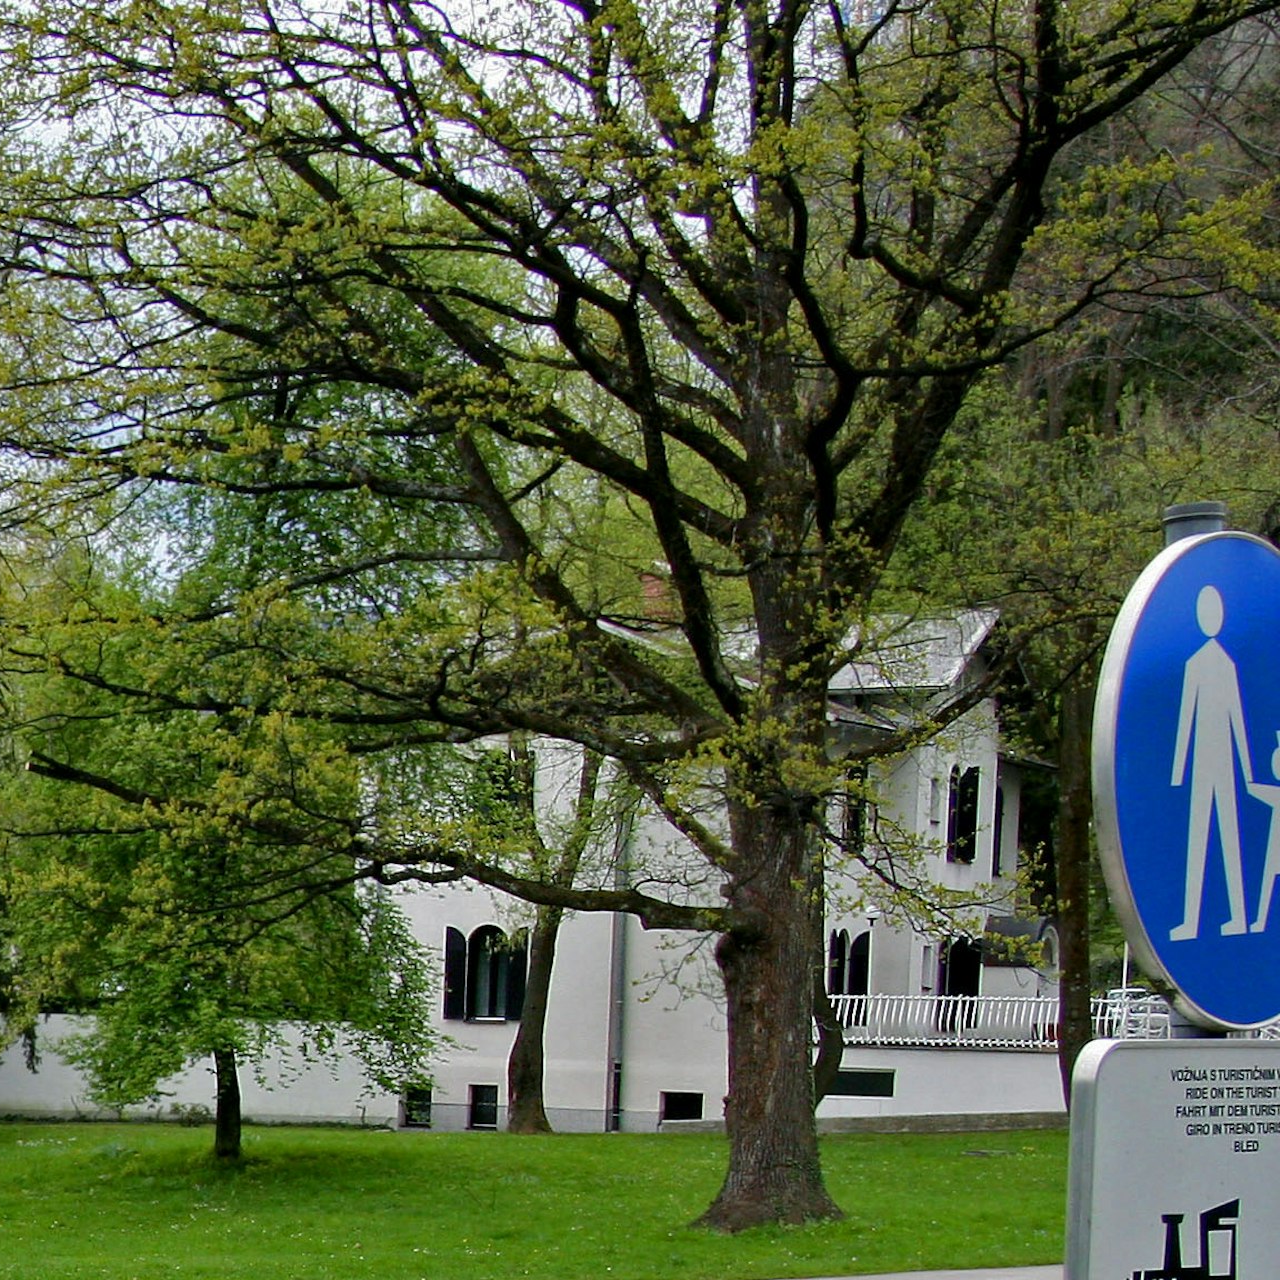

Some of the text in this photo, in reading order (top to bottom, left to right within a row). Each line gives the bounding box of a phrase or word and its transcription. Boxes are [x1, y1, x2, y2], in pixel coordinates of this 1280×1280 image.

[1171, 1066, 1207, 1081] VOŽNJA
[1210, 1069, 1216, 1080] S
[1218, 1066, 1275, 1080] TURISTIČNIM
[1186, 1087, 1277, 1099] RIDE ON THE TURIST
[1176, 1106, 1206, 1117] FAHRT
[1210, 1106, 1225, 1116] MIT
[1228, 1106, 1247, 1116] DEM
[1186, 1124, 1210, 1135] GIRO
[1213, 1124, 1221, 1135] IN
[1224, 1123, 1255, 1134] TRENO
[1234, 1141, 1259, 1152] BLED
